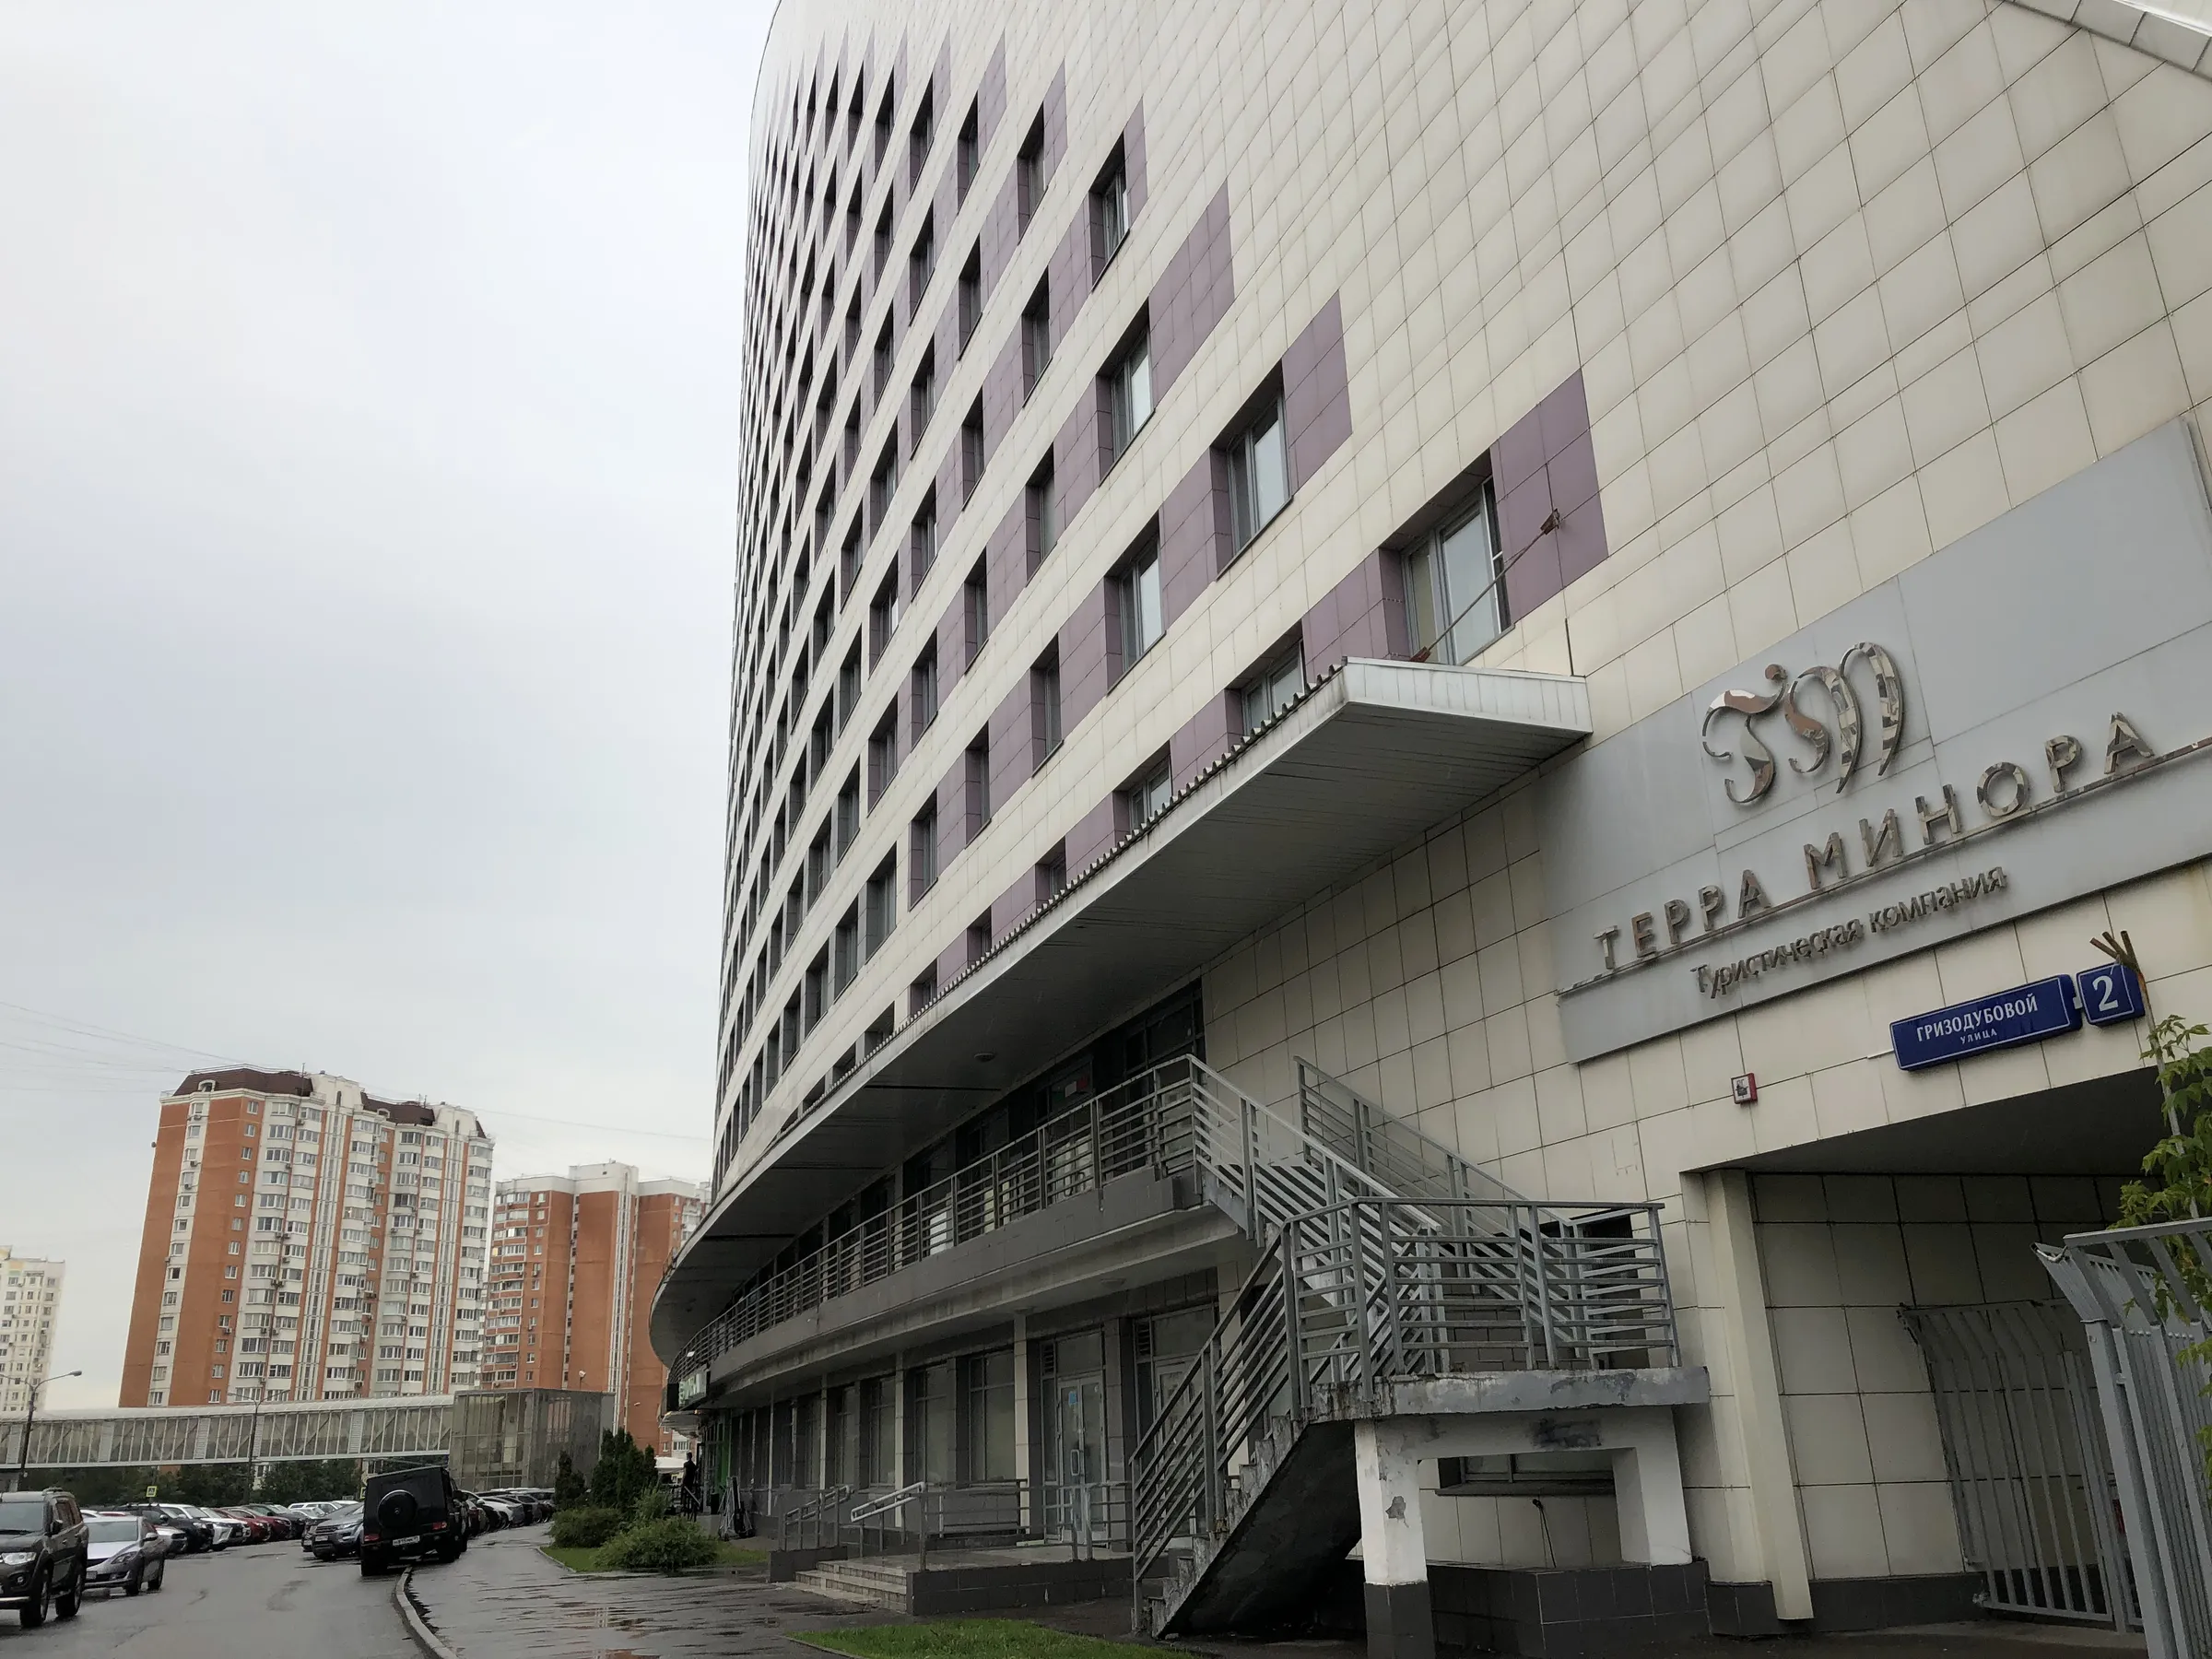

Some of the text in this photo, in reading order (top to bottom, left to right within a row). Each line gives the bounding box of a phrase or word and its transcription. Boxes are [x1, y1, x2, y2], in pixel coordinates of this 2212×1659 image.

[1593, 712, 2155, 970] ТЕРРА МИНОРА
[1690, 866, 2008, 1000] Туристическая компания
[1916, 974, 2119, 1042] ГРИЗОДУБОВОЙ 2
[1959, 1028, 1998, 1045] УЛИЦА
